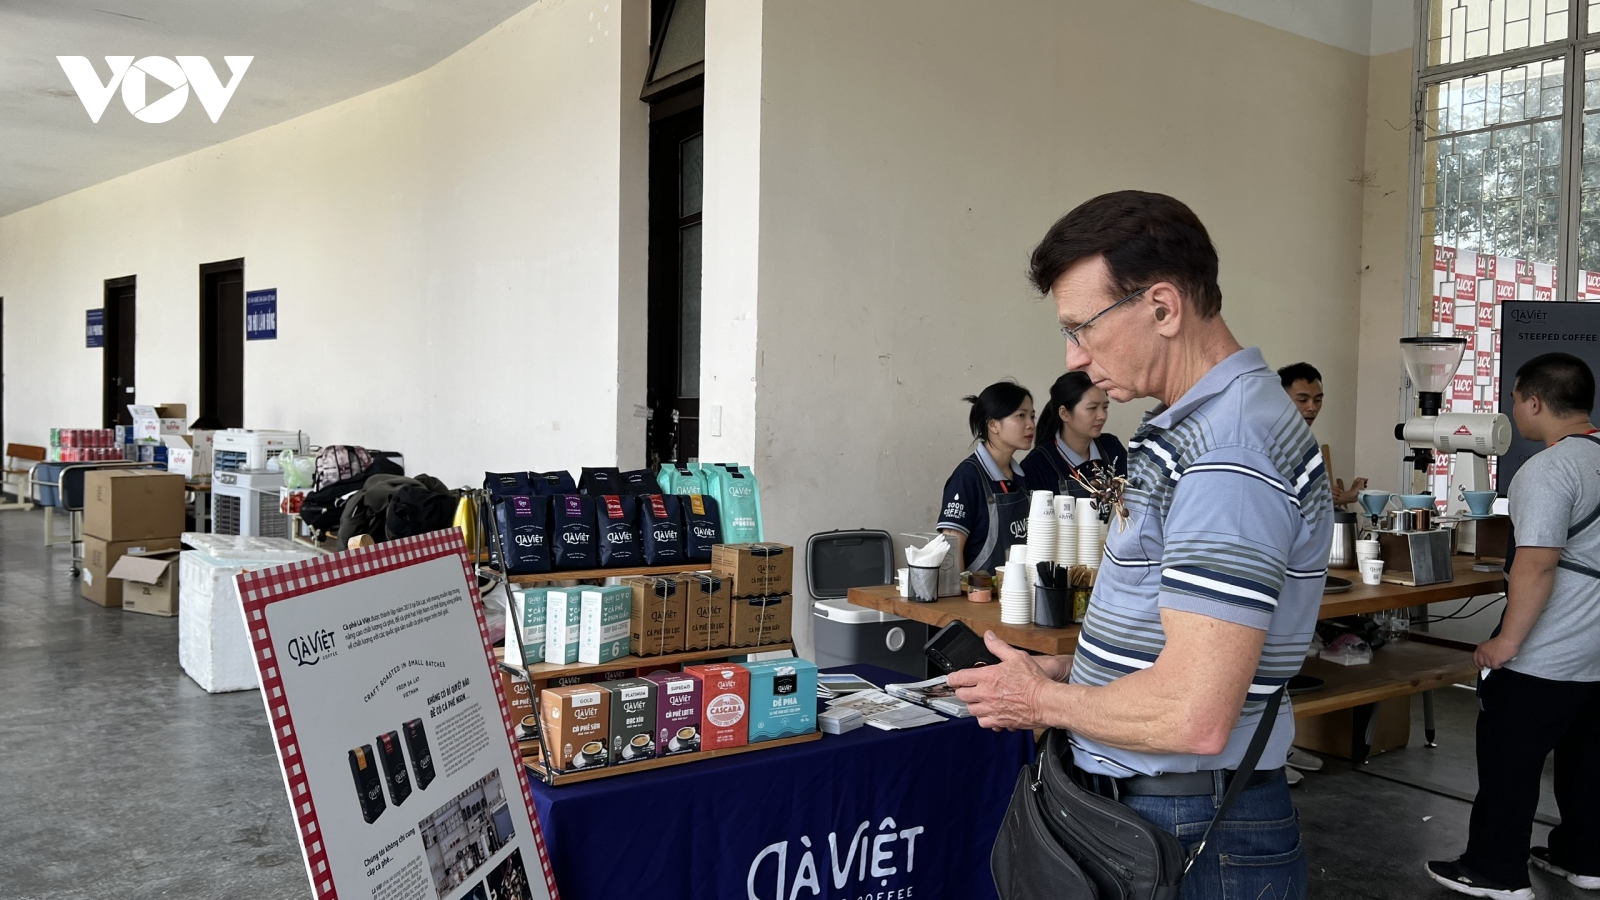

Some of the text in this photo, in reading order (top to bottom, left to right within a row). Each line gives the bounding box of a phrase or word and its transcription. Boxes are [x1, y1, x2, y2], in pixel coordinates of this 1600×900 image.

[1518, 332, 1597, 342] STEEPED COFFEE
[947, 502, 965, 511] GOOD
[943, 509, 966, 517] COFFEE
[612, 641, 619, 657] 6
[363, 685, 380, 702] CRAFT
[380, 665, 401, 687] ROASTED
[401, 661, 407, 669] IN
[408, 659, 424, 667] SMALL
[396, 681, 408, 692] FROM
[402, 687, 419, 699] VIETNAM
[427, 693, 440, 705] KHÔNG
[783, 697, 798, 706] PHA
[710, 705, 741, 715] CASCARA
[364, 854, 379, 867] Chúng
[385, 840, 399, 852] không
[405, 828, 415, 838] cung
[367, 868, 375, 877] cấp
[376, 863, 381, 871] cà
